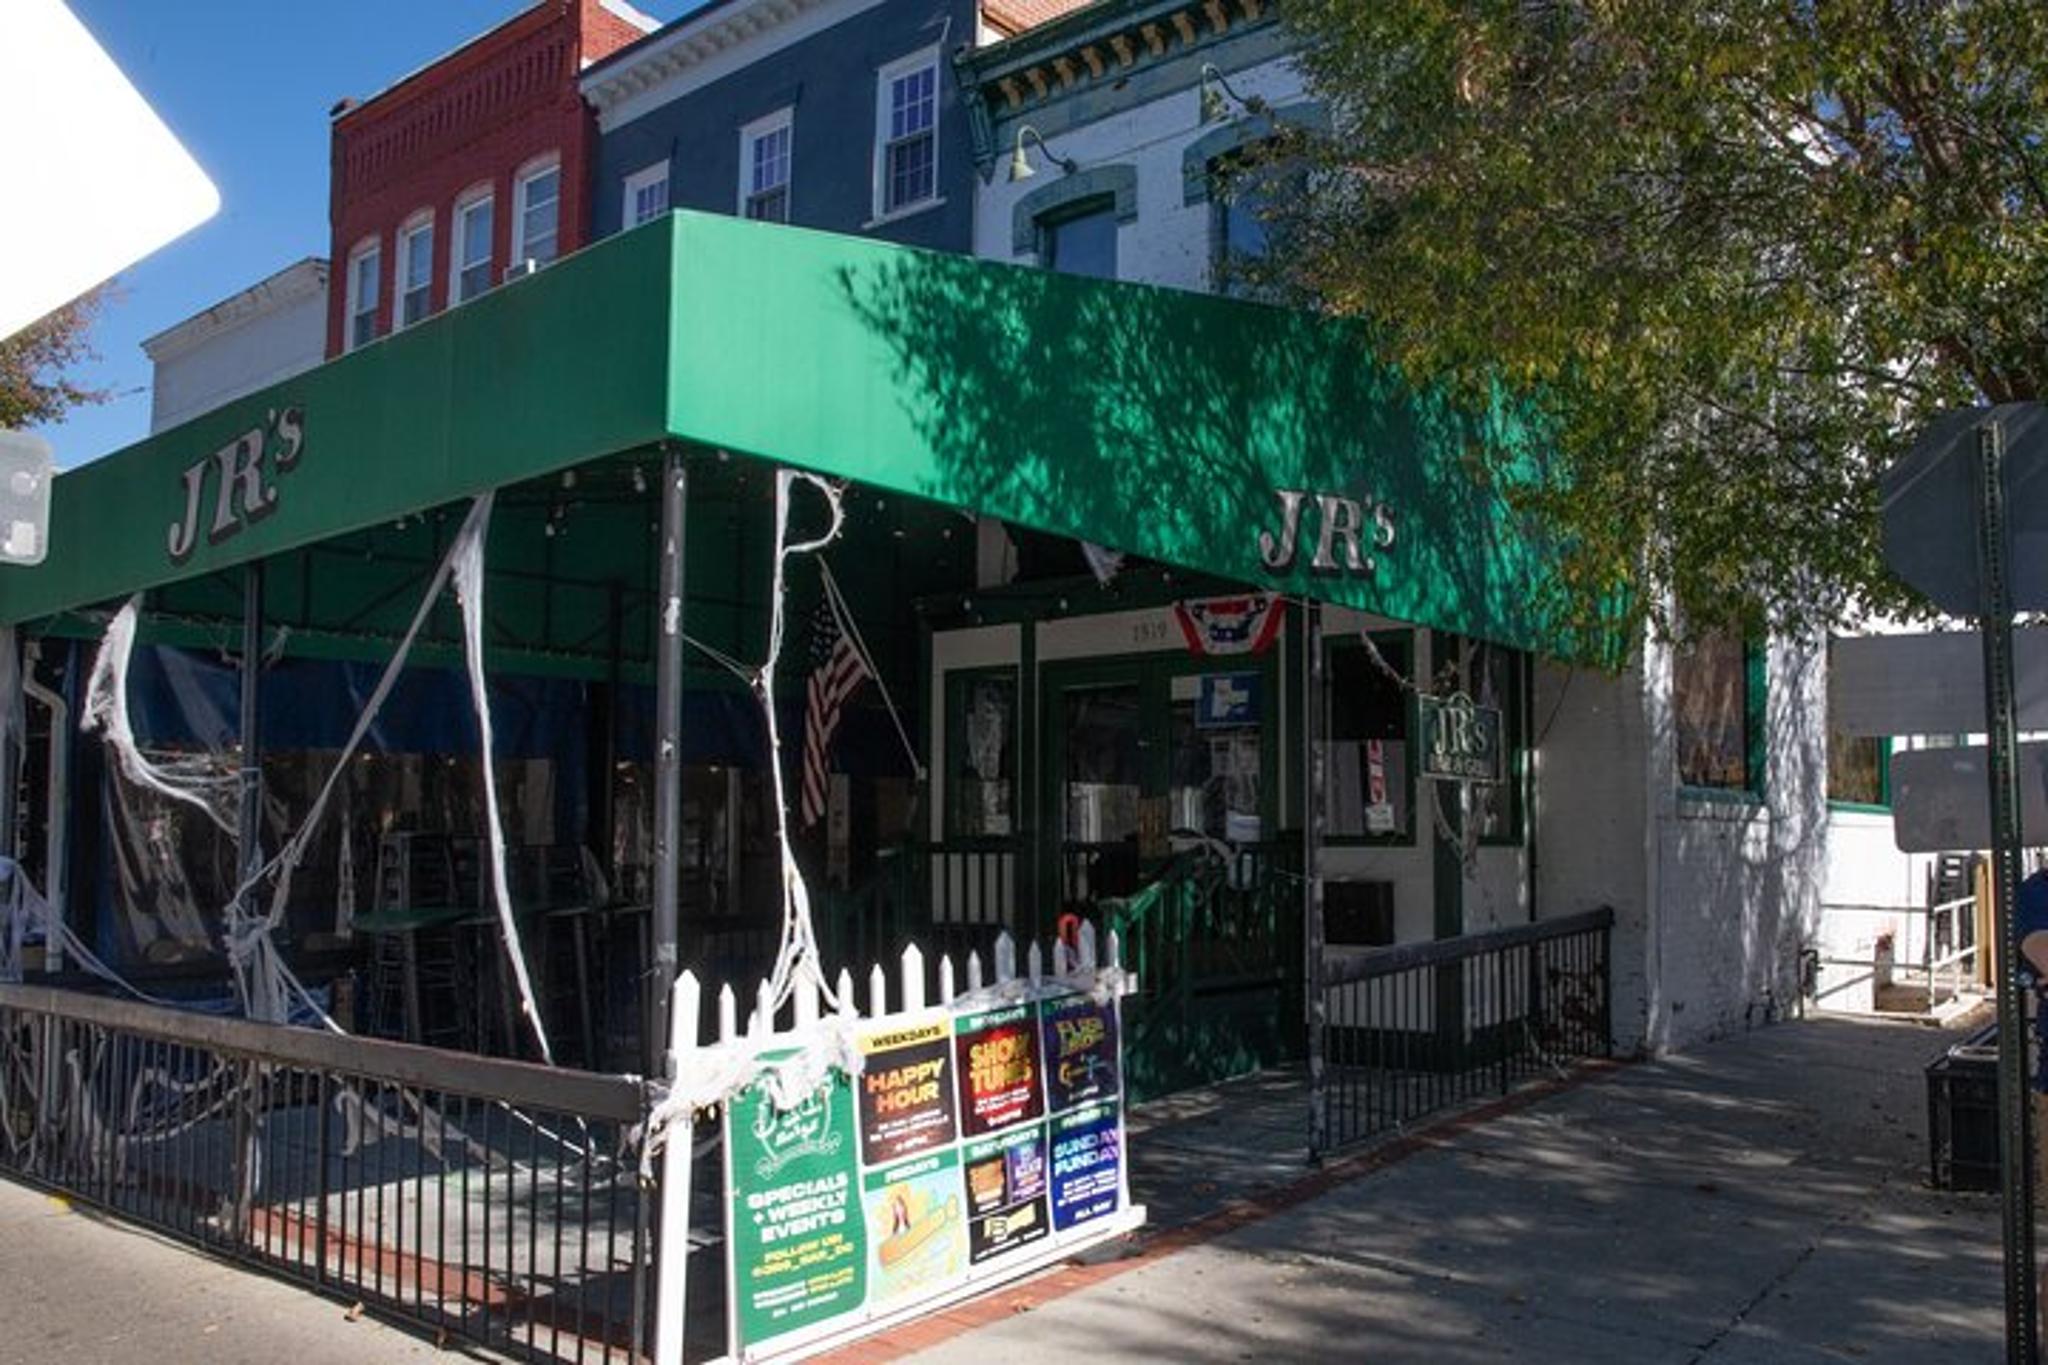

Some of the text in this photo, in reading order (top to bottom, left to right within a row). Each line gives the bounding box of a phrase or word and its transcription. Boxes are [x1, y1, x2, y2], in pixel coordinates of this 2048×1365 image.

[865, 1056, 946, 1094] HAPPY
[876, 1080, 940, 1113] HOUR
[747, 1171, 848, 1209] SPECIALS
[767, 1190, 848, 1224] WEEKLY
[761, 1208, 846, 1244] EVENTS
